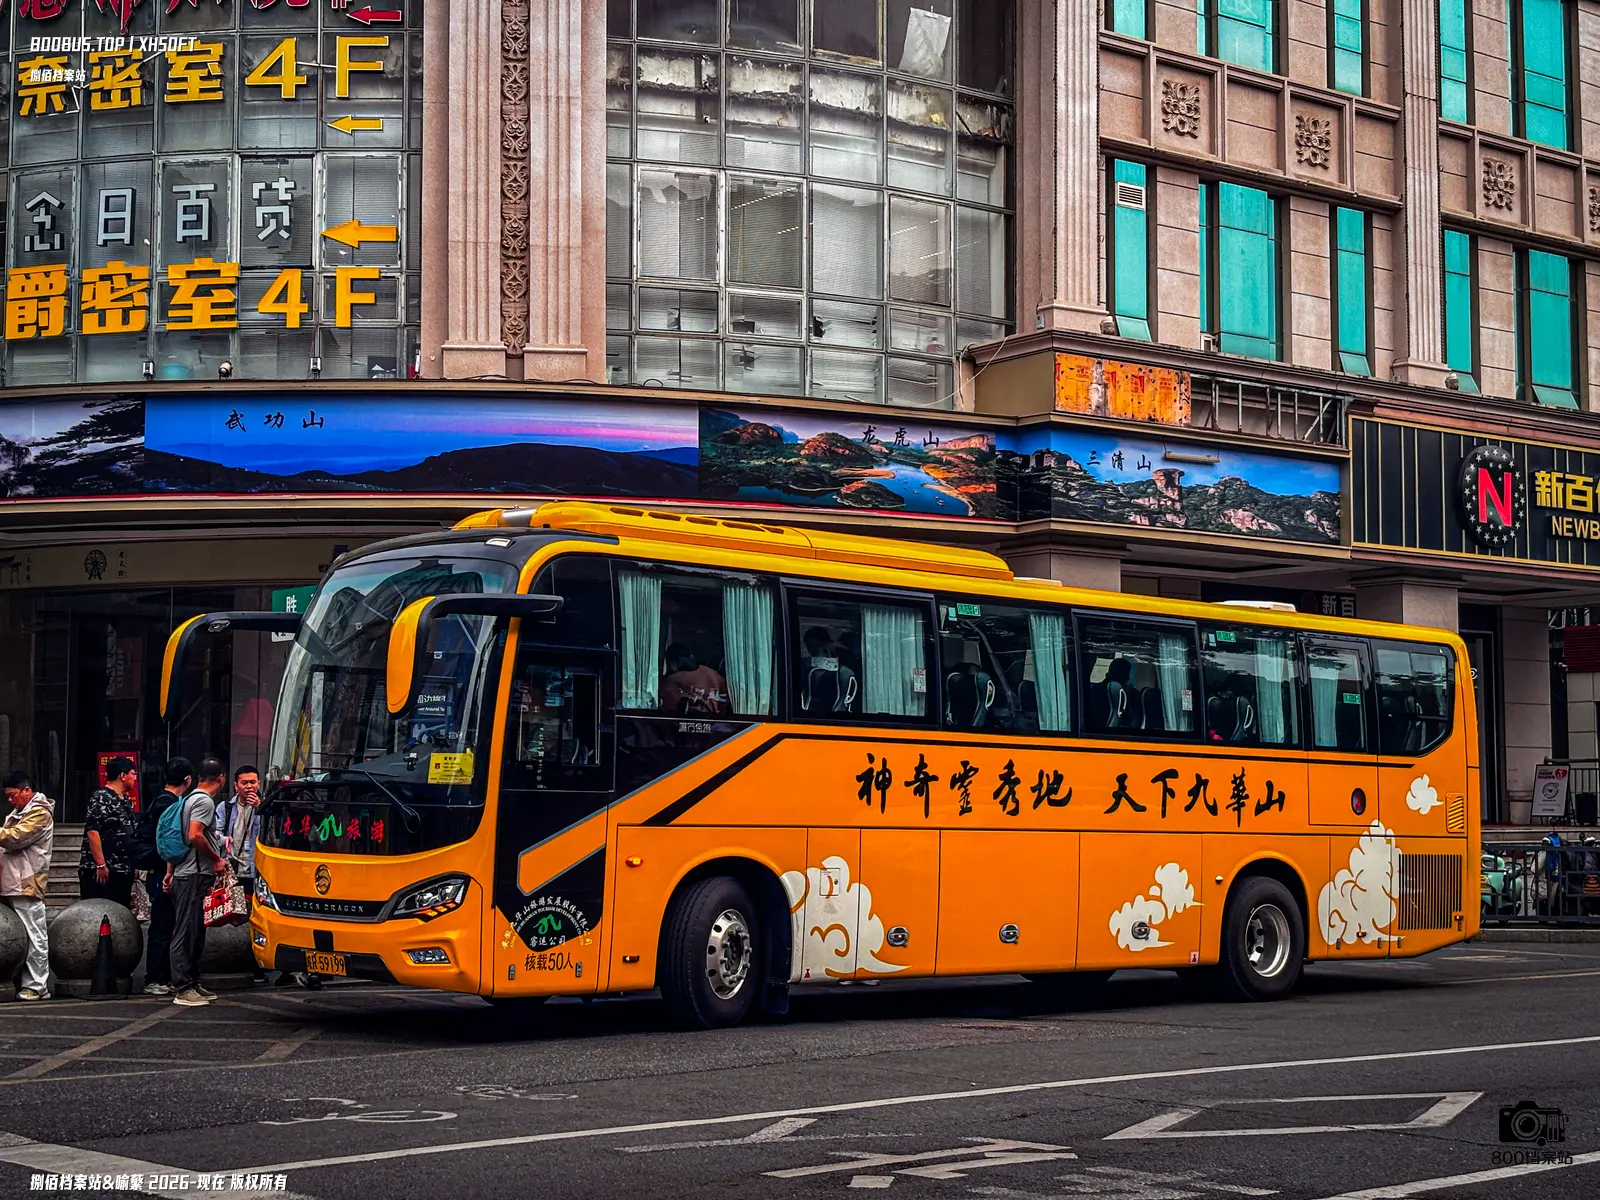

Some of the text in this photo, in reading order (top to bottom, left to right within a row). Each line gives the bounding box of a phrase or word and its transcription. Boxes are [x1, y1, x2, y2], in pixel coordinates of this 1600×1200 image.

[245, 35, 390, 99] 4F
[5, 257, 382, 340] 爵密室 4F
[224, 409, 325, 432] 武功山
[862, 425, 940, 448] 龙虎山
[1086, 450, 1151, 472] 三清山
[1478, 467, 1512, 527] N
[1535, 470, 1600, 513] 新百
[324, 904, 364, 913] DRAGON
[525, 952, 573, 971] 核载50人
